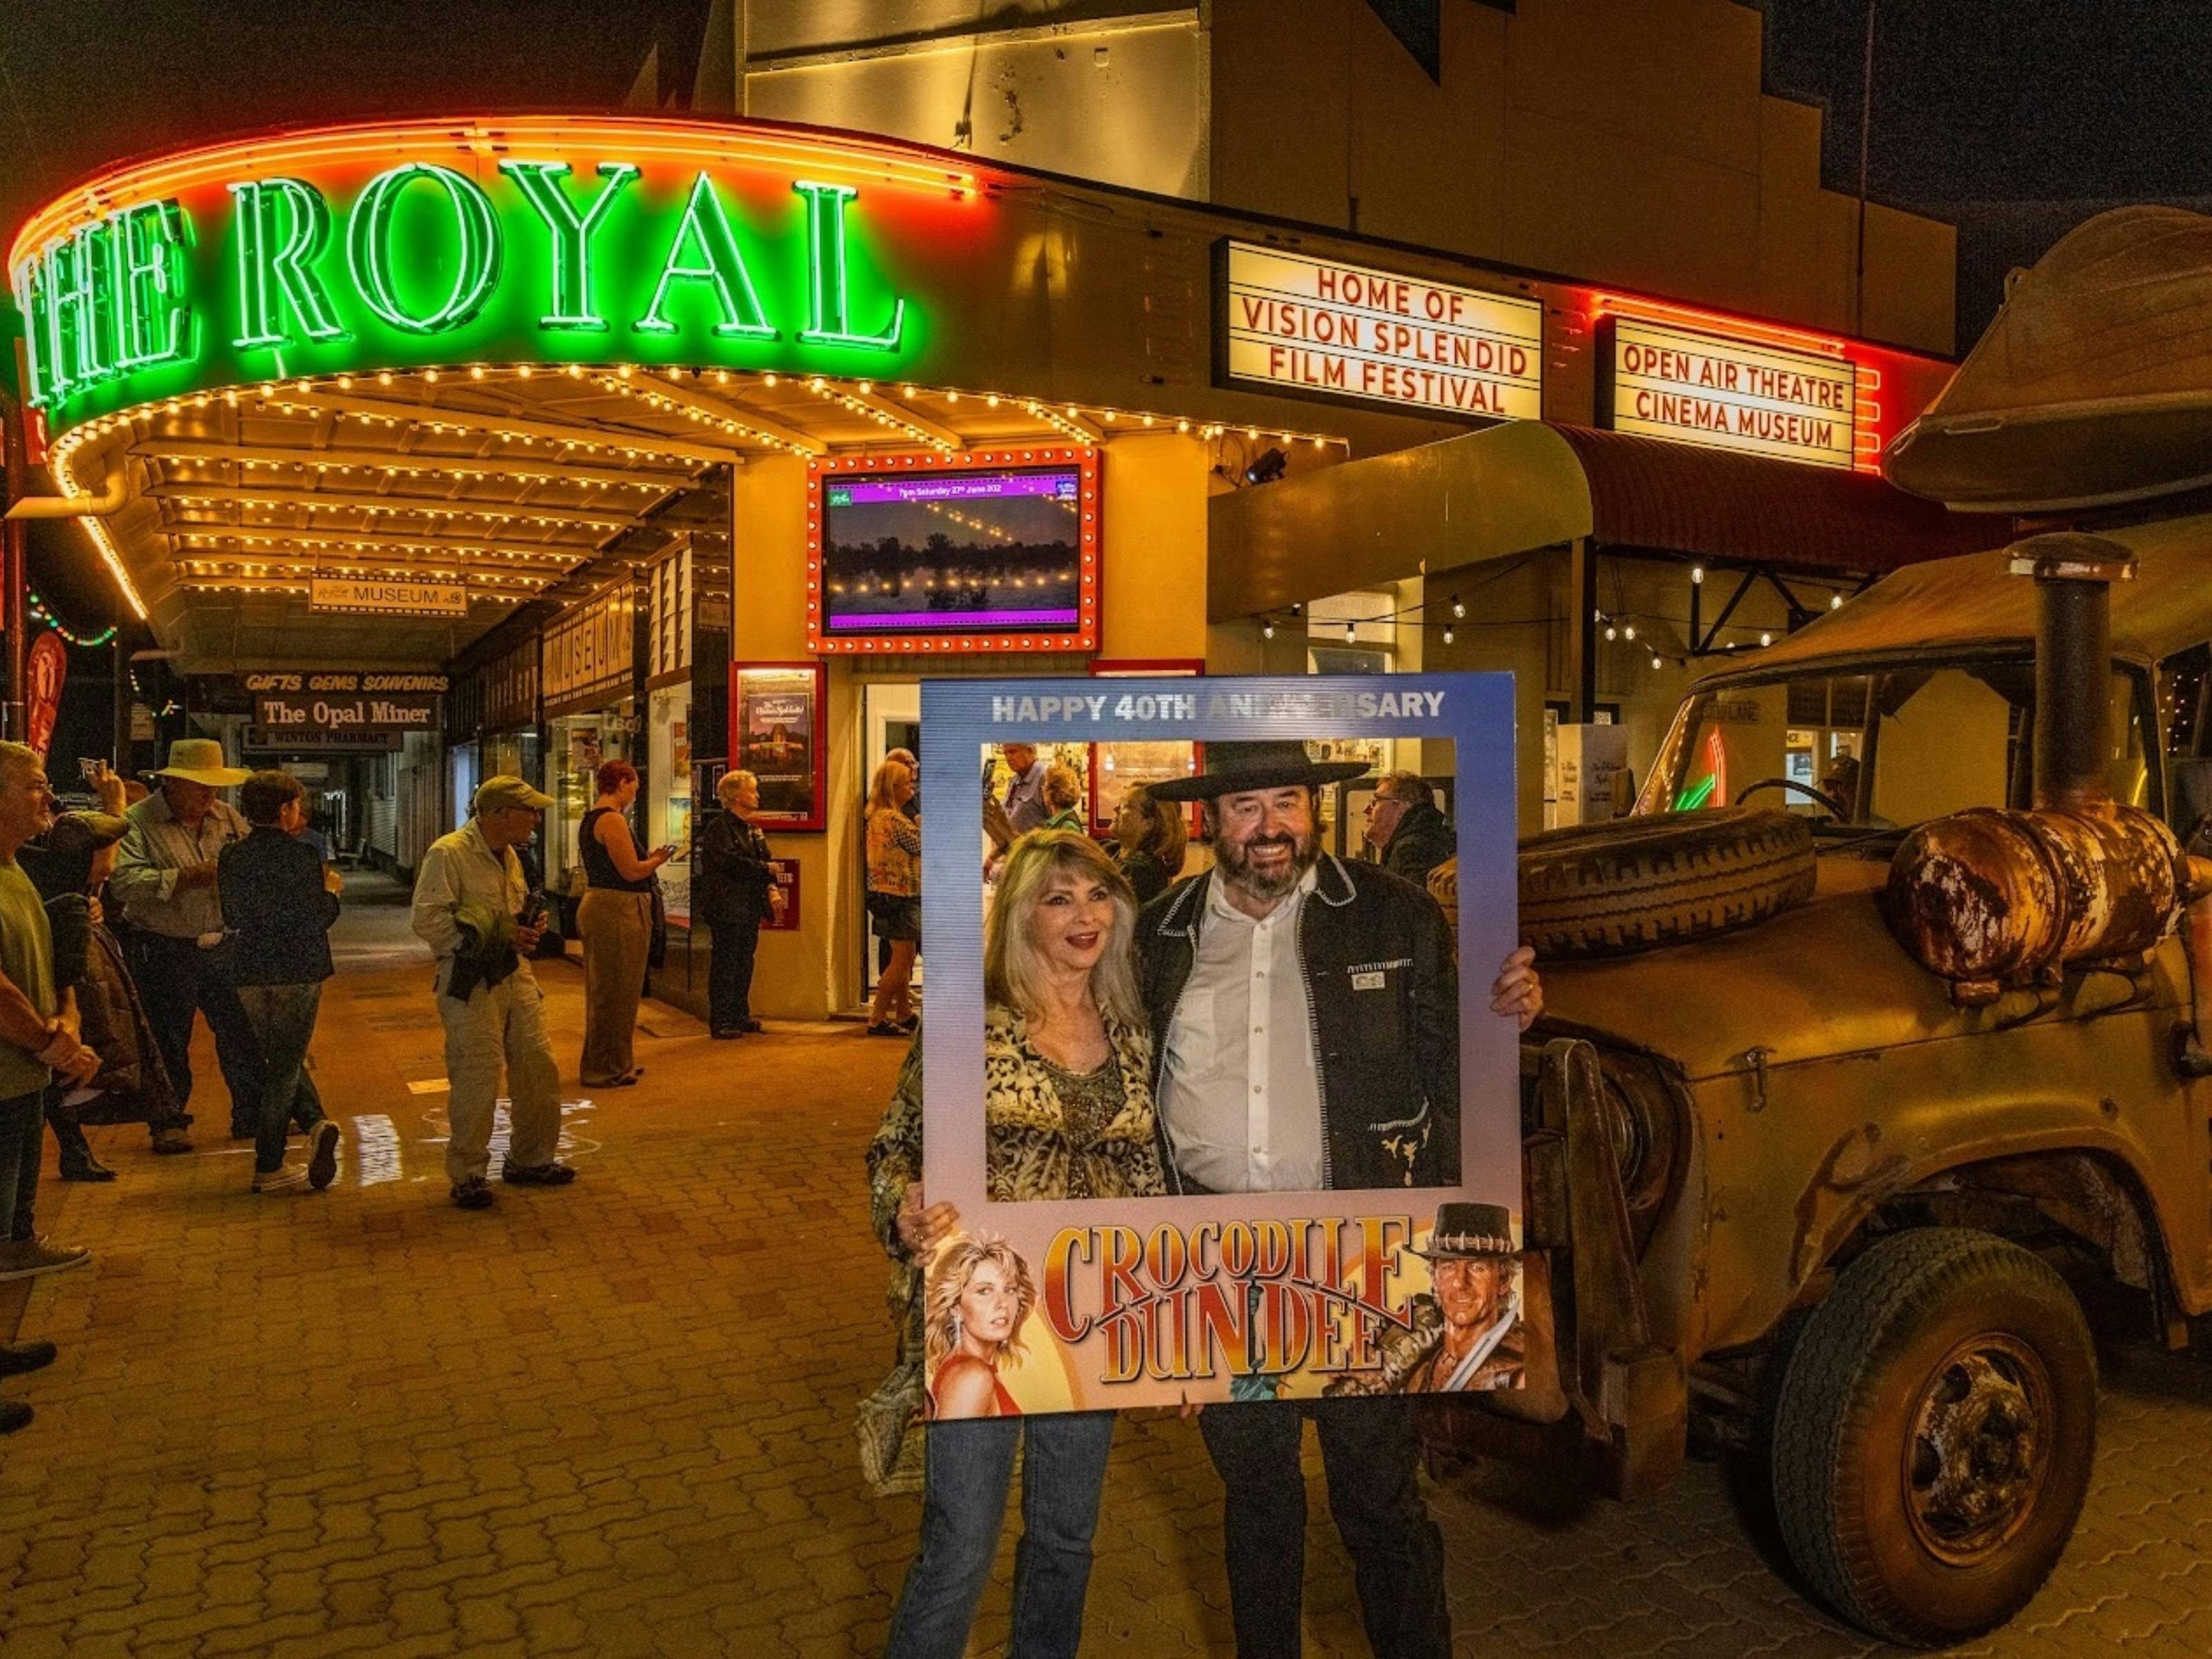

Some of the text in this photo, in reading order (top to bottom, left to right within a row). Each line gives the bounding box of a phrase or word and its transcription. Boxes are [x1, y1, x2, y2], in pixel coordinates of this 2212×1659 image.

[12, 159, 905, 408] THE ROYAL
[1318, 267, 1464, 323] HOME OF
[1242, 297, 1526, 375] VISION SPLENDID
[1269, 346, 1506, 413] FILM FESTIVAL
[1624, 345, 1844, 409] OPEN AIR THEATRE
[1635, 391, 1833, 448] CINEMA MUSEUM
[917, 487, 950, 496] Saturday
[353, 586, 439, 603] MUSEUM
[246, 674, 449, 691] GIFTS GEMS SOUVENIRS
[991, 694, 1107, 722] HAPPY
[1114, 693, 1196, 721] 40TH
[263, 700, 431, 729] The Opal Miner
[326, 731, 388, 744] PHARMACY
[1043, 1215, 1412, 1343] CROCODILE
[1100, 1277, 1385, 1384] DUNDEE
